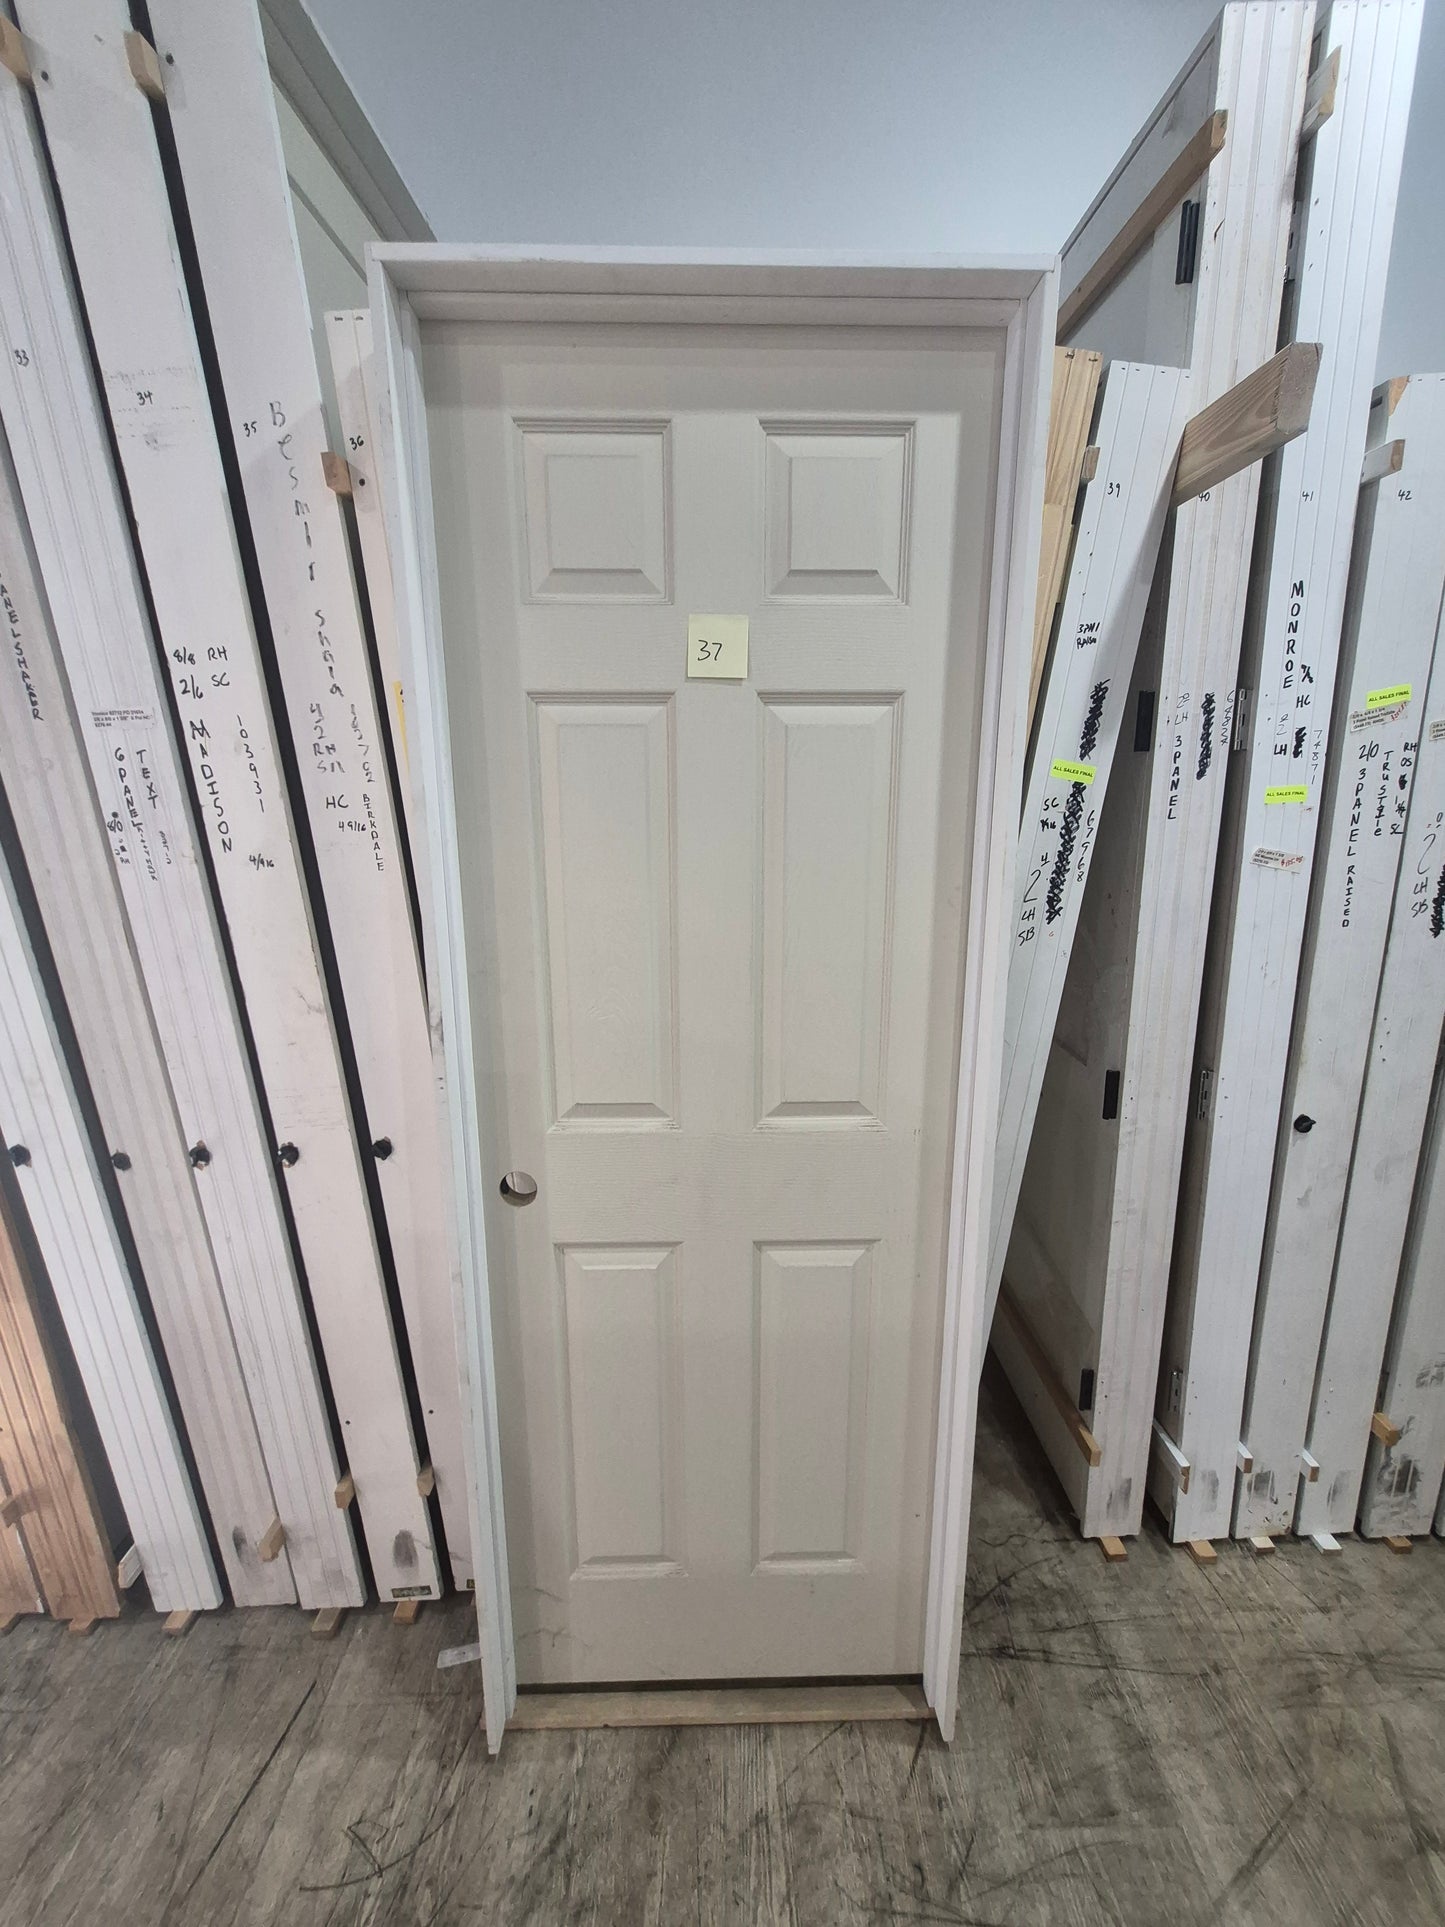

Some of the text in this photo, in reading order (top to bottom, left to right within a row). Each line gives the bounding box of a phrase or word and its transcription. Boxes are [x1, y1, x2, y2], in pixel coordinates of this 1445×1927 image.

[14, 349, 30, 367] 33
[136, 390, 154, 406] 34
[243, 421, 258, 437] 35
[349, 435, 365, 450] 36
[1107, 482, 1121, 498] 39
[1302, 491, 1314, 502] 41
[1397, 489, 1413, 501] 42
[0, 573, 21, 639] ANEL
[1283, 580, 1304, 689] MONROE
[207, 646, 228, 661] RH
[697, 639, 722, 661] 37
[211, 672, 230, 687] SC
[1296, 694, 1311, 708] HC
[1175, 711, 1189, 725] LH
[1273, 743, 1288, 756] LH
[1403, 742, 1417, 752] RH
[136, 749, 159, 809] TEXT
[1063, 767, 1079, 775] SALES
[1080, 770, 1094, 778] FINAL
[1167, 735, 1182, 820] 3 PANEL
[189, 719, 232, 853] MADISON
[118, 768, 143, 828] PANEL
[326, 794, 349, 809] HC
[1043, 796, 1060, 811] SC
[363, 793, 384, 872] BIRKDALE
[1341, 768, 1367, 928] 3 PANEL RAISED
[1413, 877, 1428, 895] LH
[1018, 926, 1035, 946] SB
